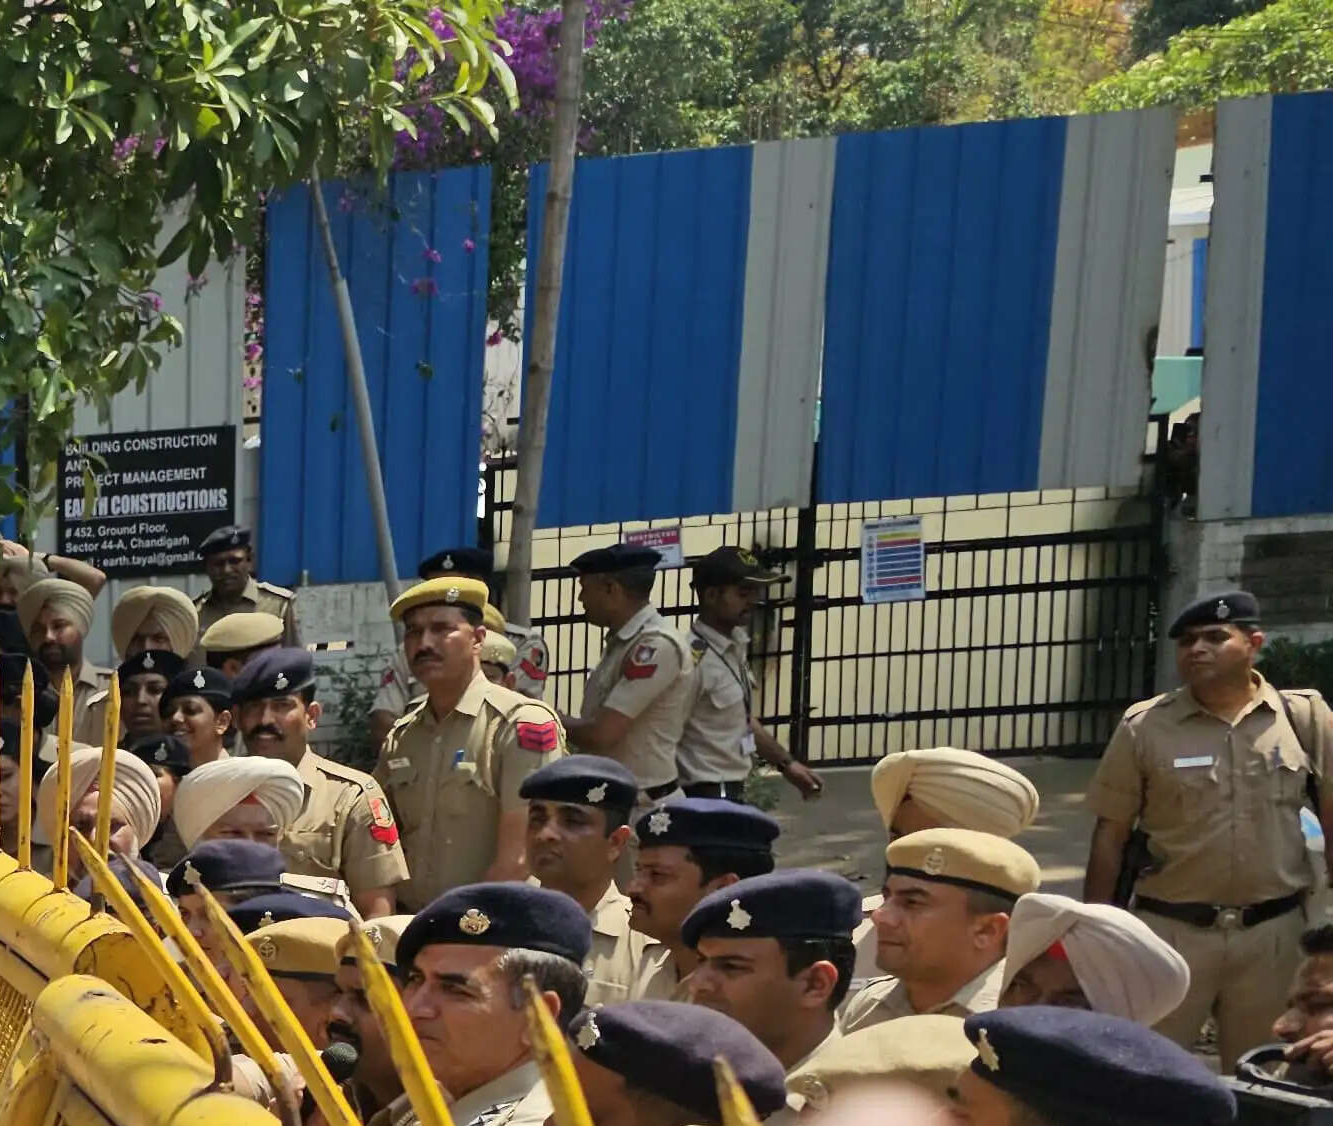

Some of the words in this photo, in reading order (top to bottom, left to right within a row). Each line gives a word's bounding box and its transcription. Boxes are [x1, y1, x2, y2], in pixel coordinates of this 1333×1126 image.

[124, 434, 218, 451] CONSTRUCTION
[65, 473, 119, 488] PRECT
[123, 467, 206, 484] MANAGEMENT
[65, 496, 109, 518] EATH
[111, 488, 228, 515] CONSTRUCTIONS
[98, 524, 136, 536] Ground
[139, 522, 168, 534] Floor,
[65, 541, 99, 553] Sector
[130, 534, 190, 549] Chandigarh
